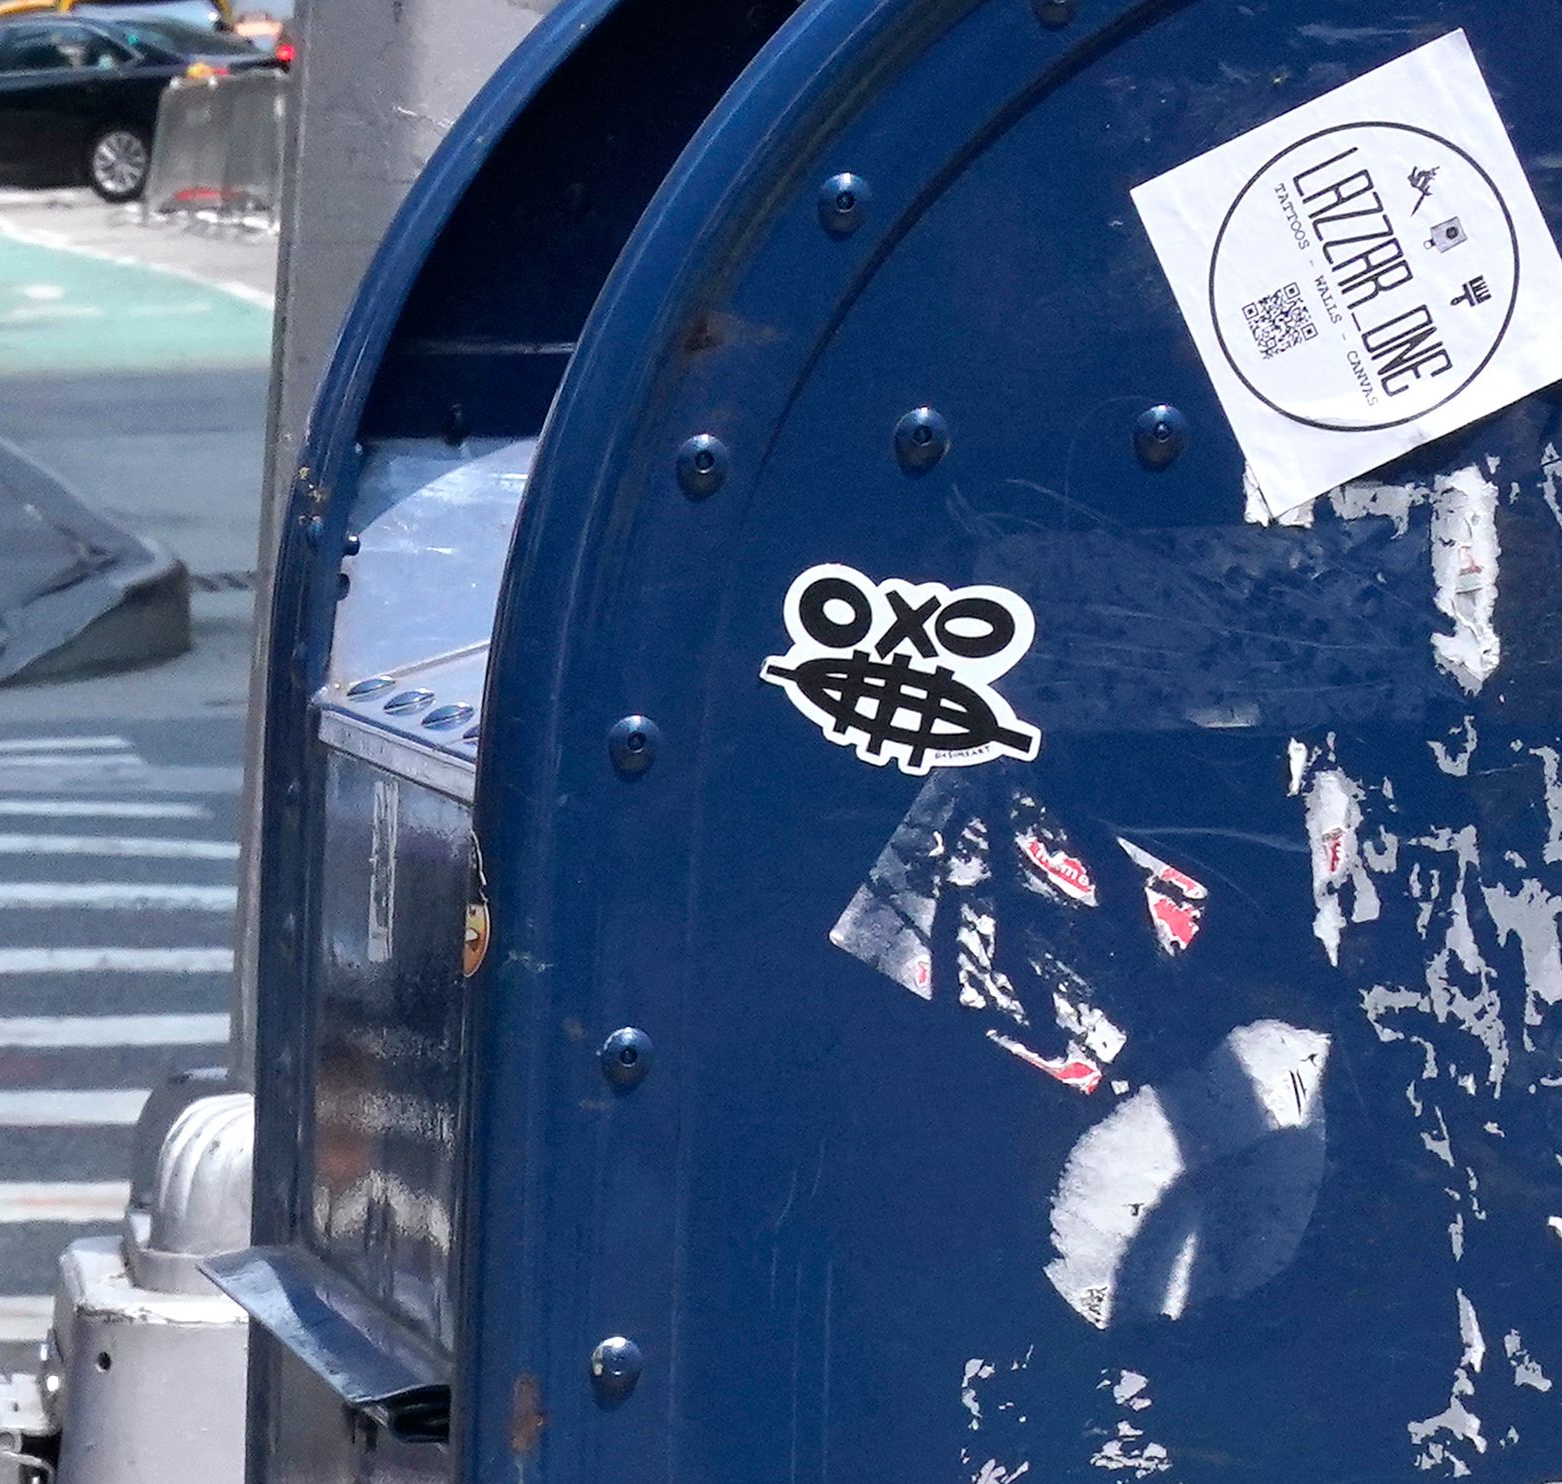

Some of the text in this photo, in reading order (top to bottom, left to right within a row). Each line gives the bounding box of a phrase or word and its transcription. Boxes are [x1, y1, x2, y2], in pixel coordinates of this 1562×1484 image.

[1274, 183, 1310, 250] TATTOOS
[1313, 274, 1344, 325] WALLS
[1346, 350, 1379, 407] CANVAS
